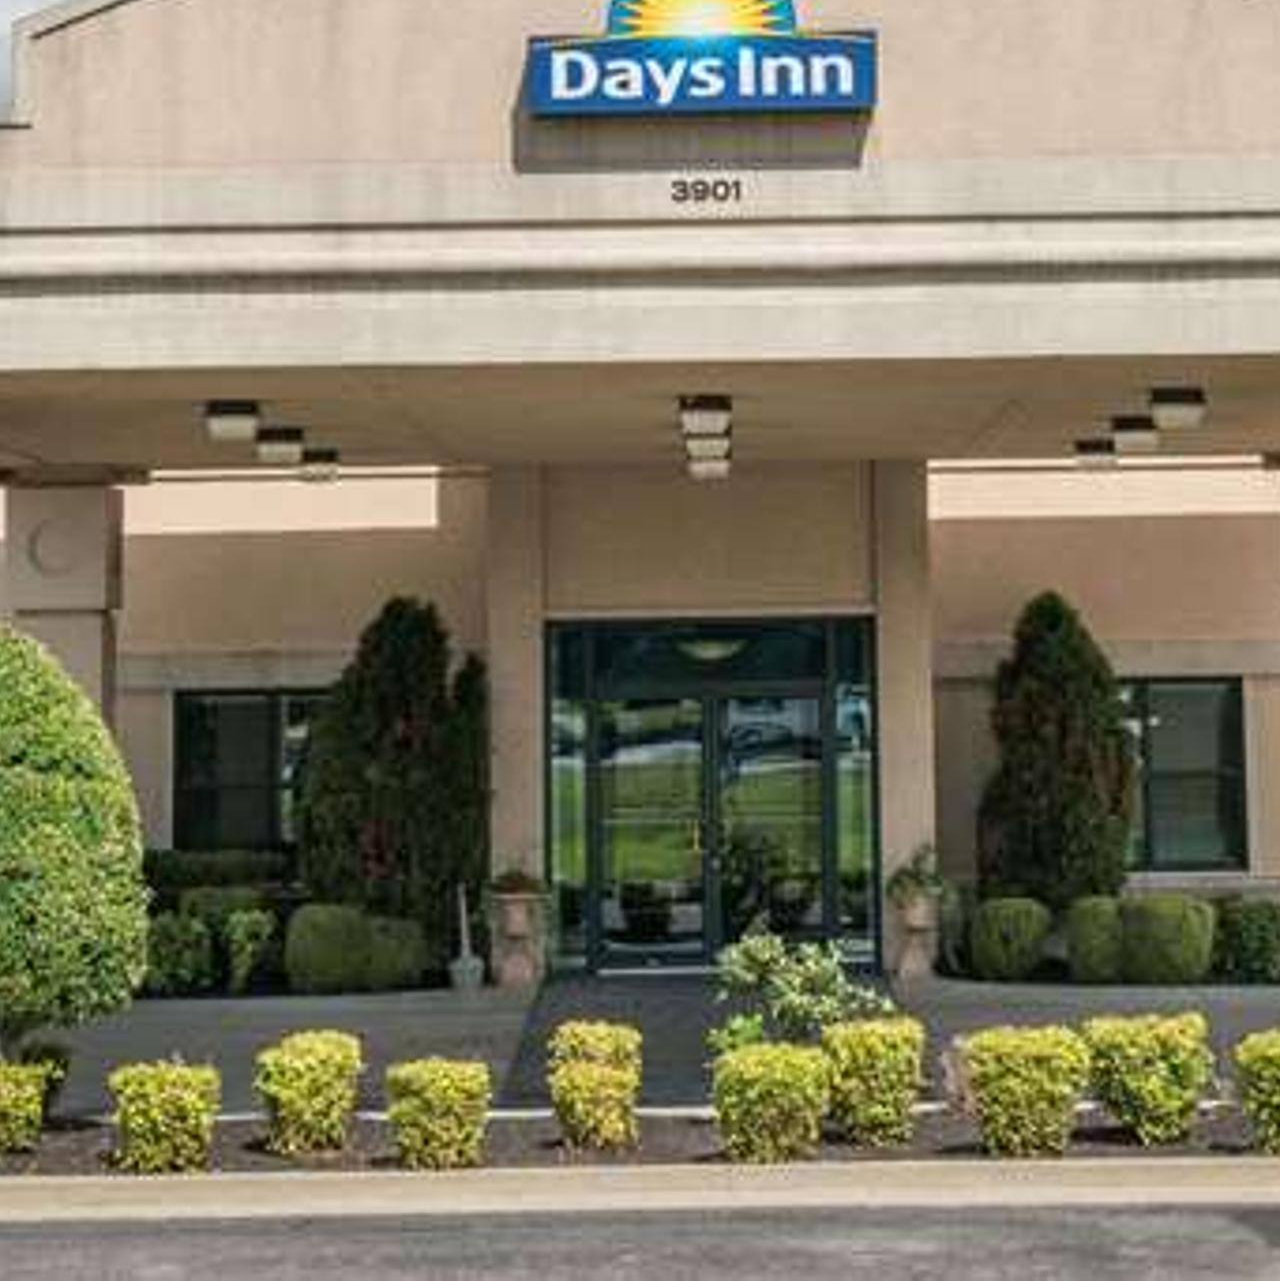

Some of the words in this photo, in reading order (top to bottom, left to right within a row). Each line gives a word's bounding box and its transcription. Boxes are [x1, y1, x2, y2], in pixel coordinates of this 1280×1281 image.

[550, 49, 726, 106] Days
[738, 46, 854, 97] Inn
[671, 180, 743, 203] 3901
